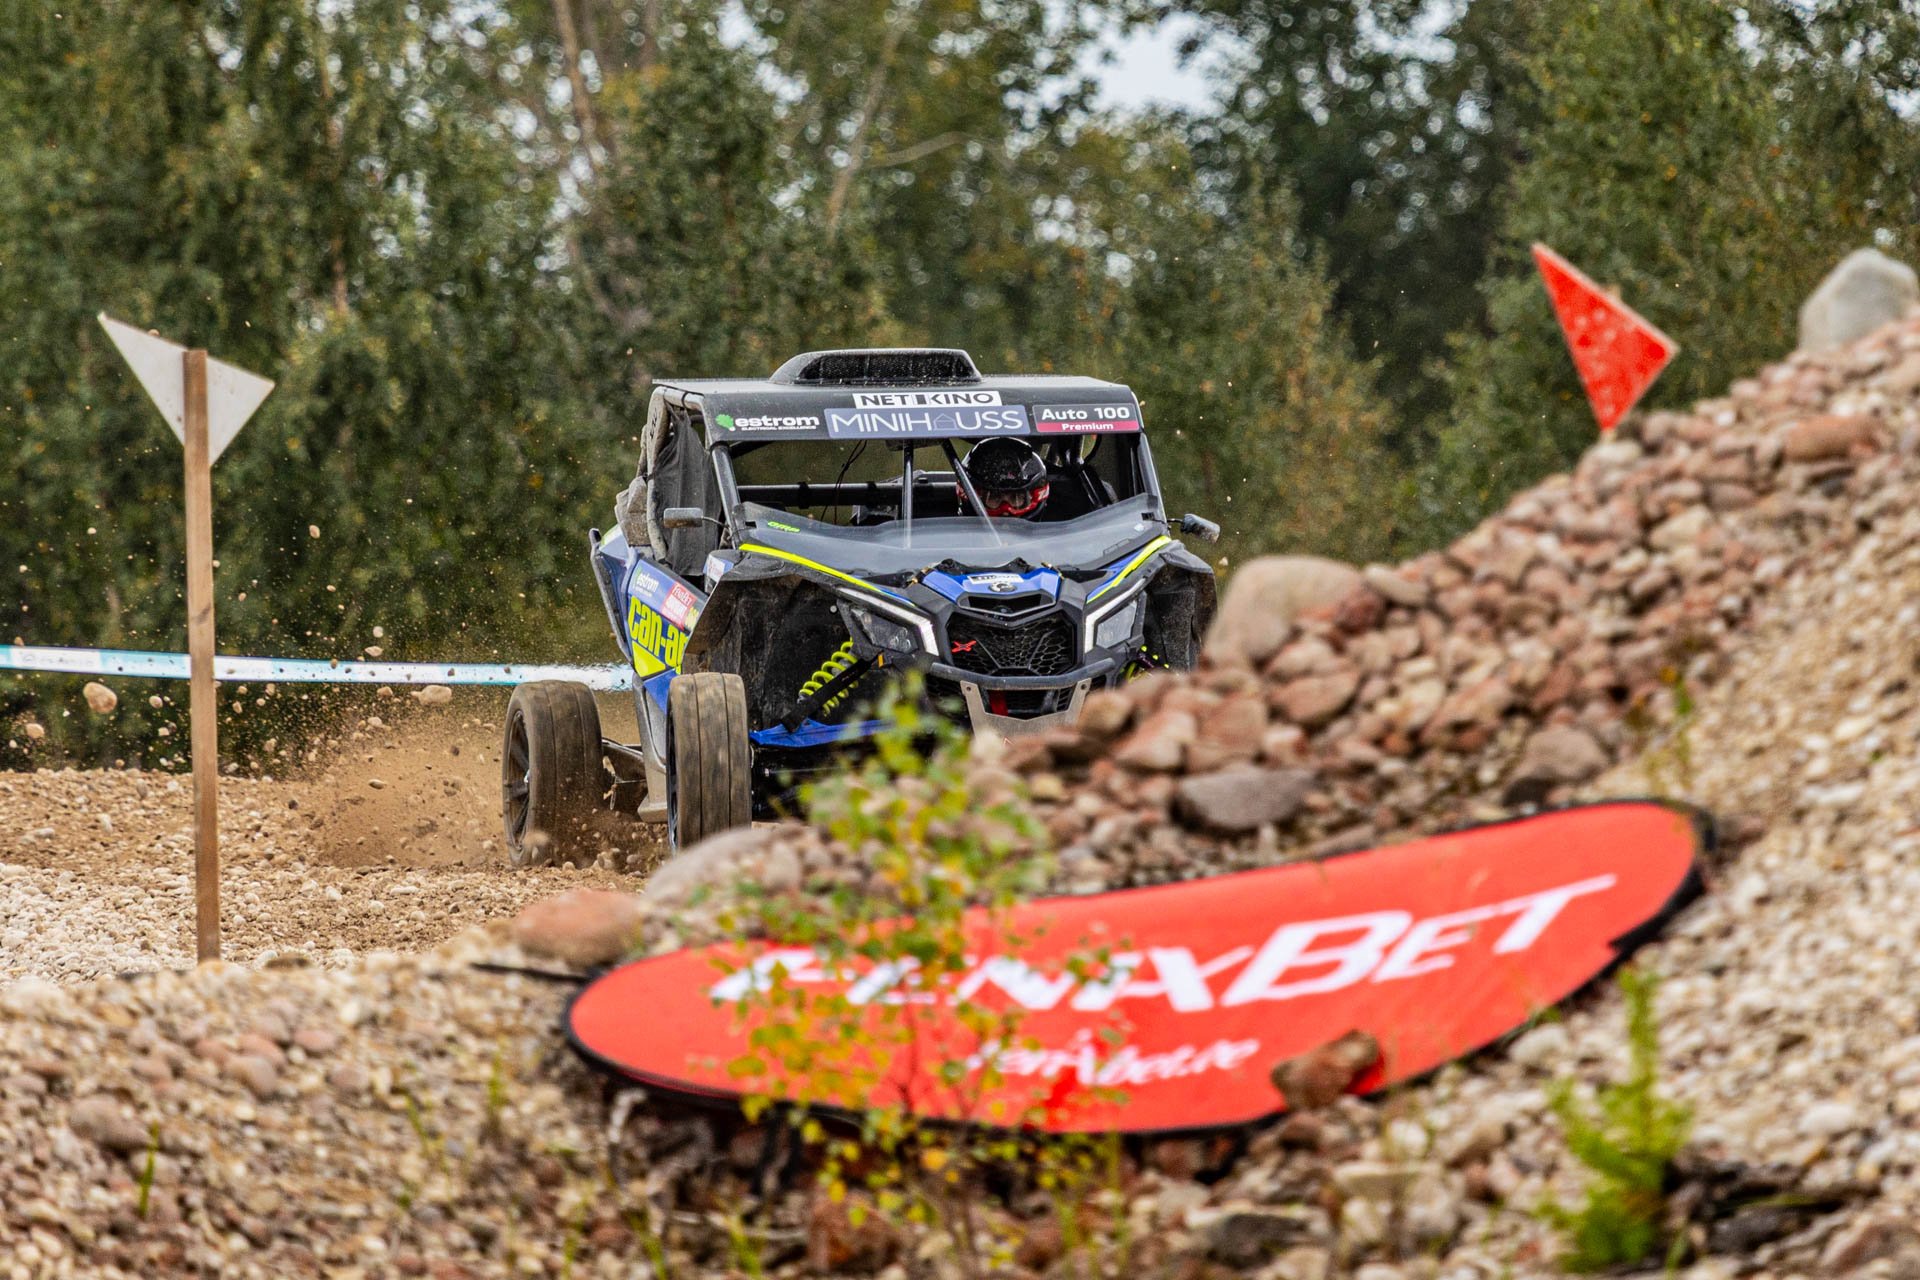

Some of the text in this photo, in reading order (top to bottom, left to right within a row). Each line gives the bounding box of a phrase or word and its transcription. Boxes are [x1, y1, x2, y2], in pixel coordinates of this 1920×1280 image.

[1041, 407, 1130, 420] Auto 100
[735, 415, 820, 427] estrom
[1061, 423, 1114, 431] Premium
